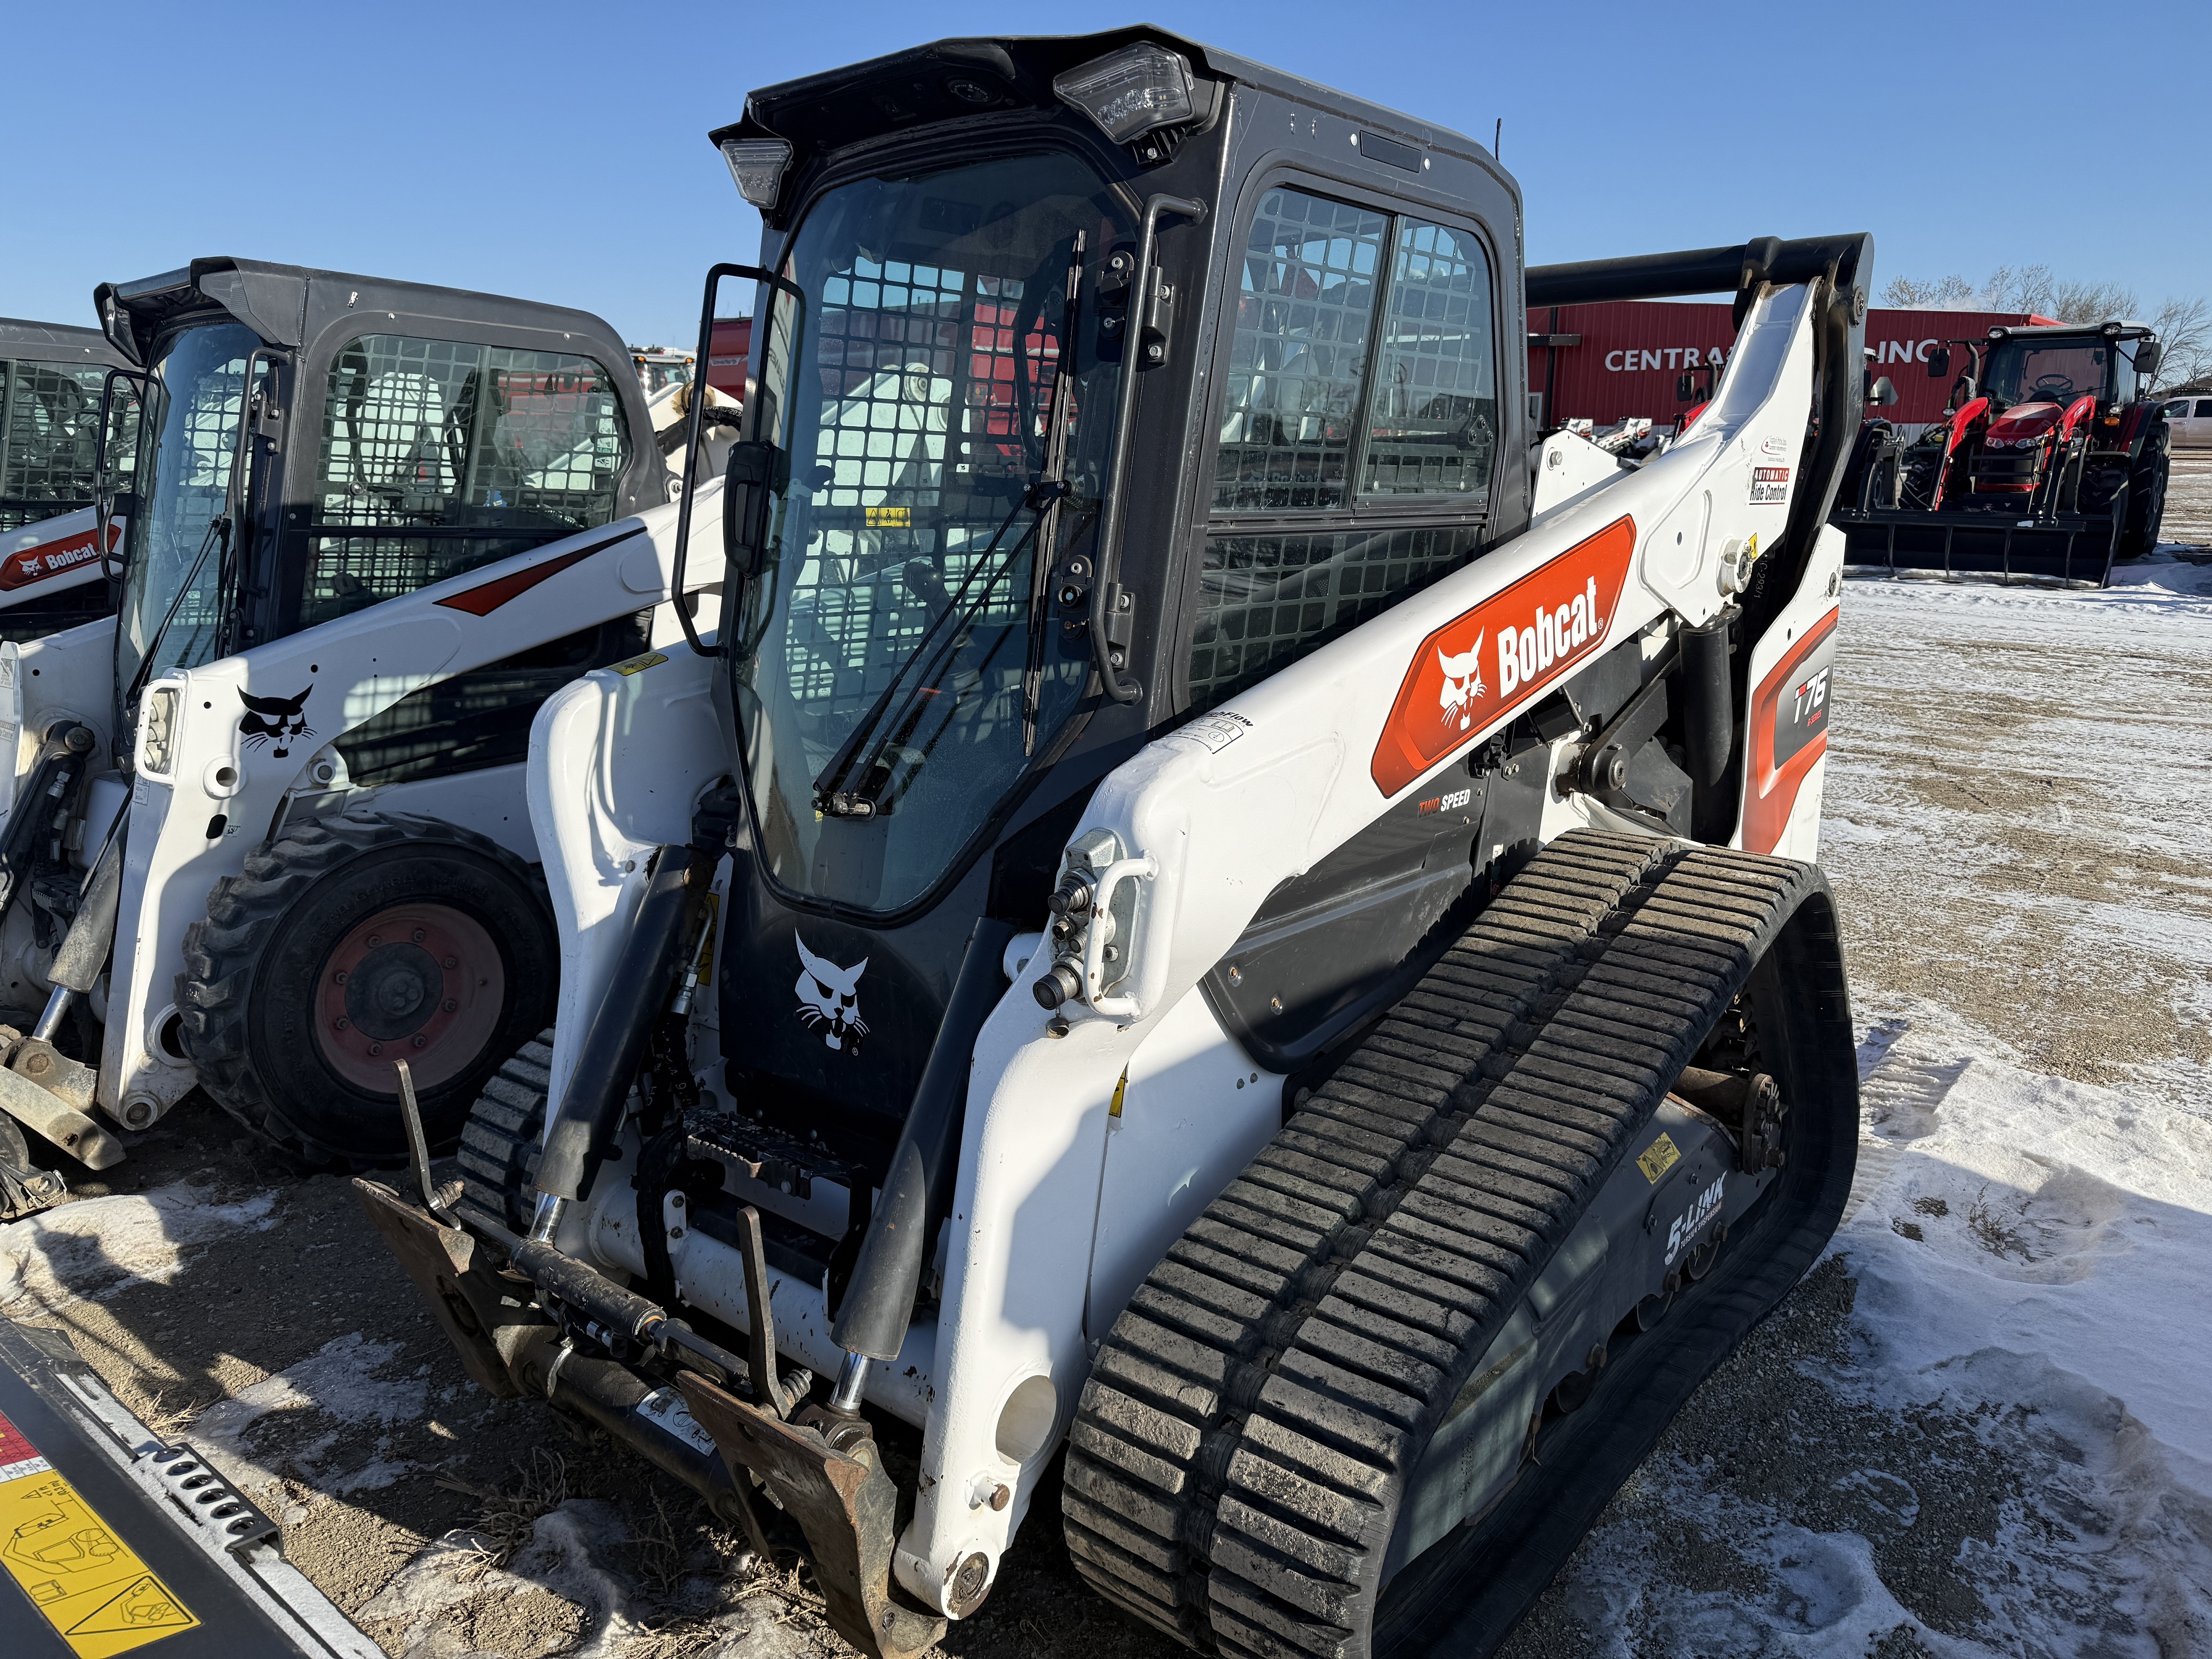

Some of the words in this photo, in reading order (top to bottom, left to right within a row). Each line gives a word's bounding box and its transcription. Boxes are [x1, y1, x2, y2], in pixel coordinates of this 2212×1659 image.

[1605, 346, 1725, 371] CENTRA
[1878, 339, 1938, 364] INC
[1755, 469, 1788, 481] AUTOMATIC
[1750, 484, 1764, 500] Ride
[1765, 484, 1787, 500] Control
[45, 543, 98, 570] Bobcat
[1497, 575, 1598, 699] Bobcat
[1794, 665, 1829, 724] T76
[1419, 797, 1440, 817] TWO
[1441, 789, 1471, 812] SPEED
[1664, 1170, 1727, 1266] 5-LINK
[1681, 1225, 1697, 1249] TORSION
[1698, 1200, 1722, 1230] SUSPENSION
